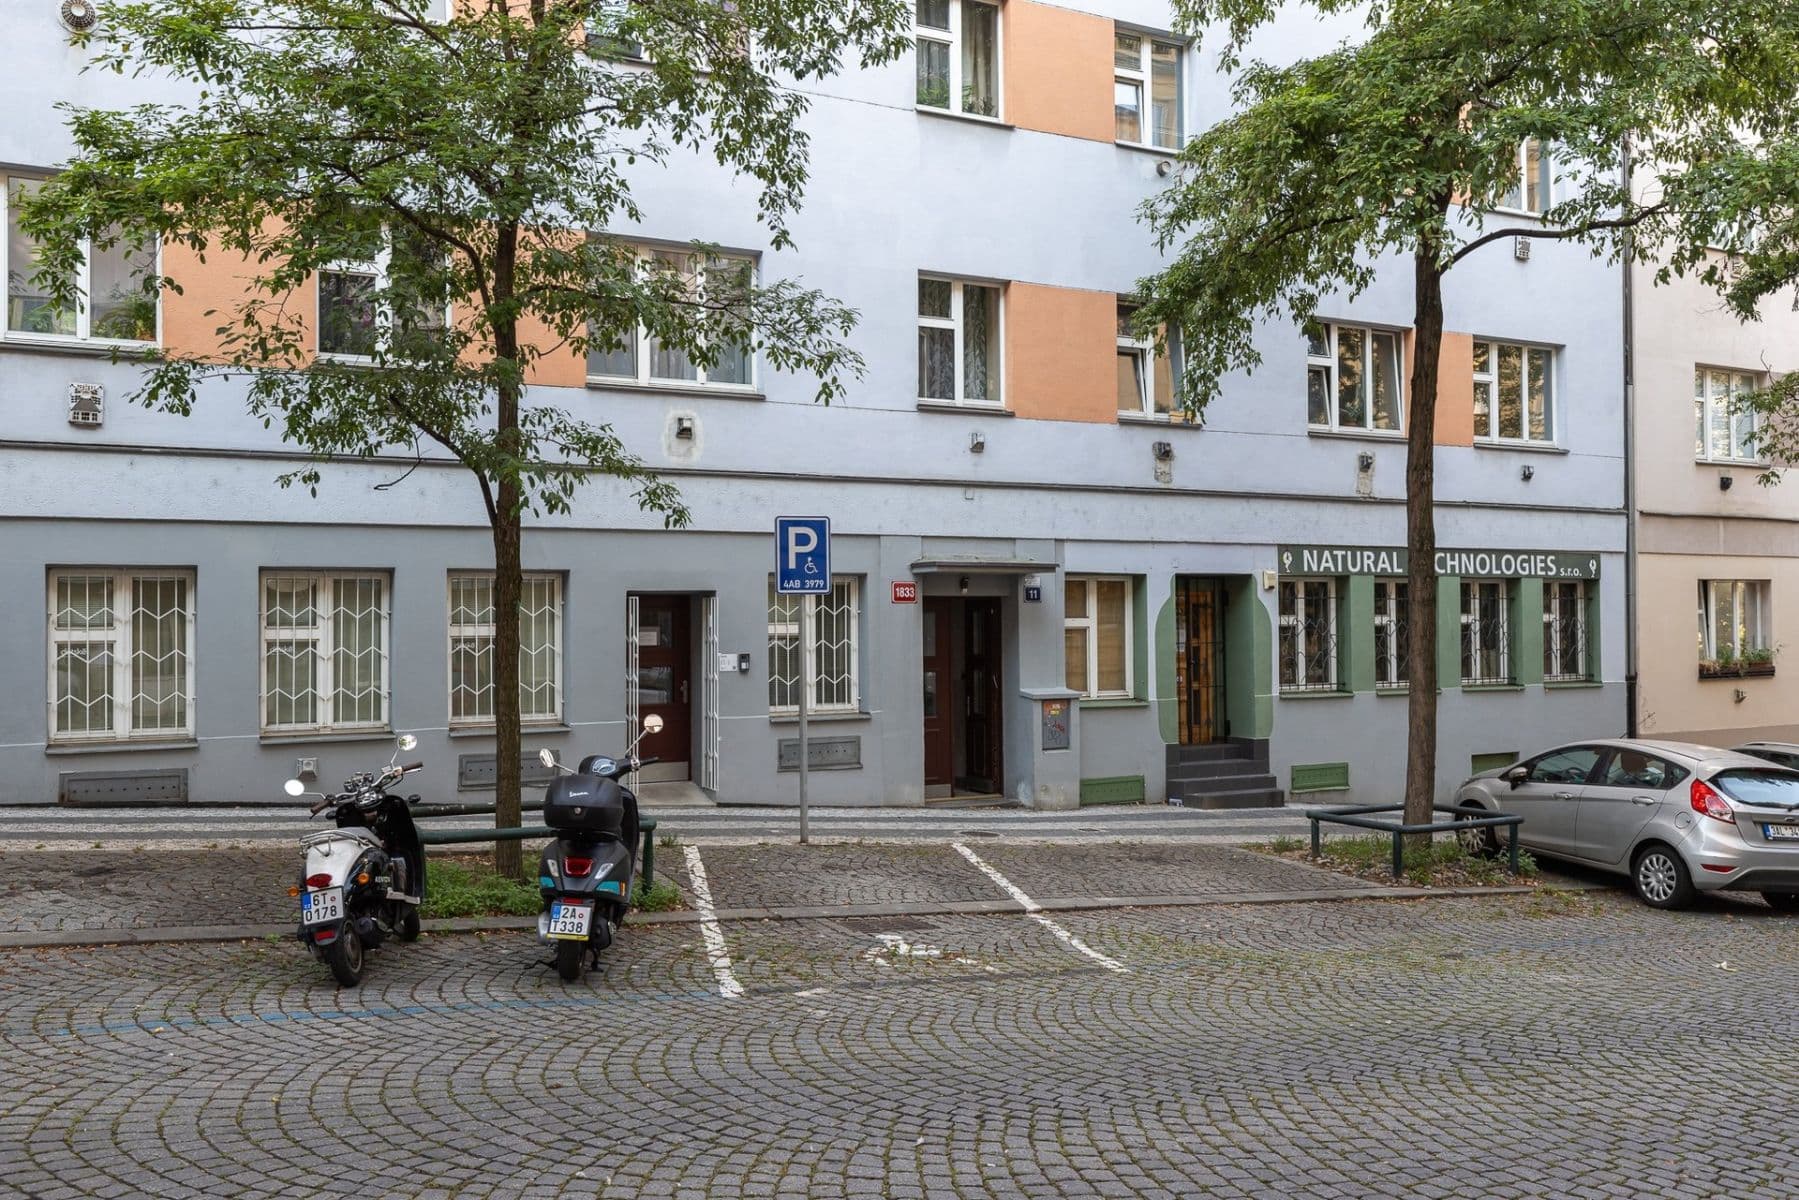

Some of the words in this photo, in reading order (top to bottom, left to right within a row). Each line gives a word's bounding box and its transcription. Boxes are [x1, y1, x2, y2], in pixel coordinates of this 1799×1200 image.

[788, 526, 818, 570] P
[1303, 550, 1403, 573] NATURAL
[1434, 552, 1557, 576] CHNOLOGIES
[1559, 567, 1583, 577] s.r.o.
[783, 579, 801, 589] 4AB
[804, 579, 825, 589] 3979
[895, 586, 915, 598] 1833
[1028, 589, 1038, 599] 11
[312, 892, 328, 906] 6T
[305, 904, 337, 922] 0178
[561, 906, 577, 920] 2A
[552, 919, 584, 934] T338
